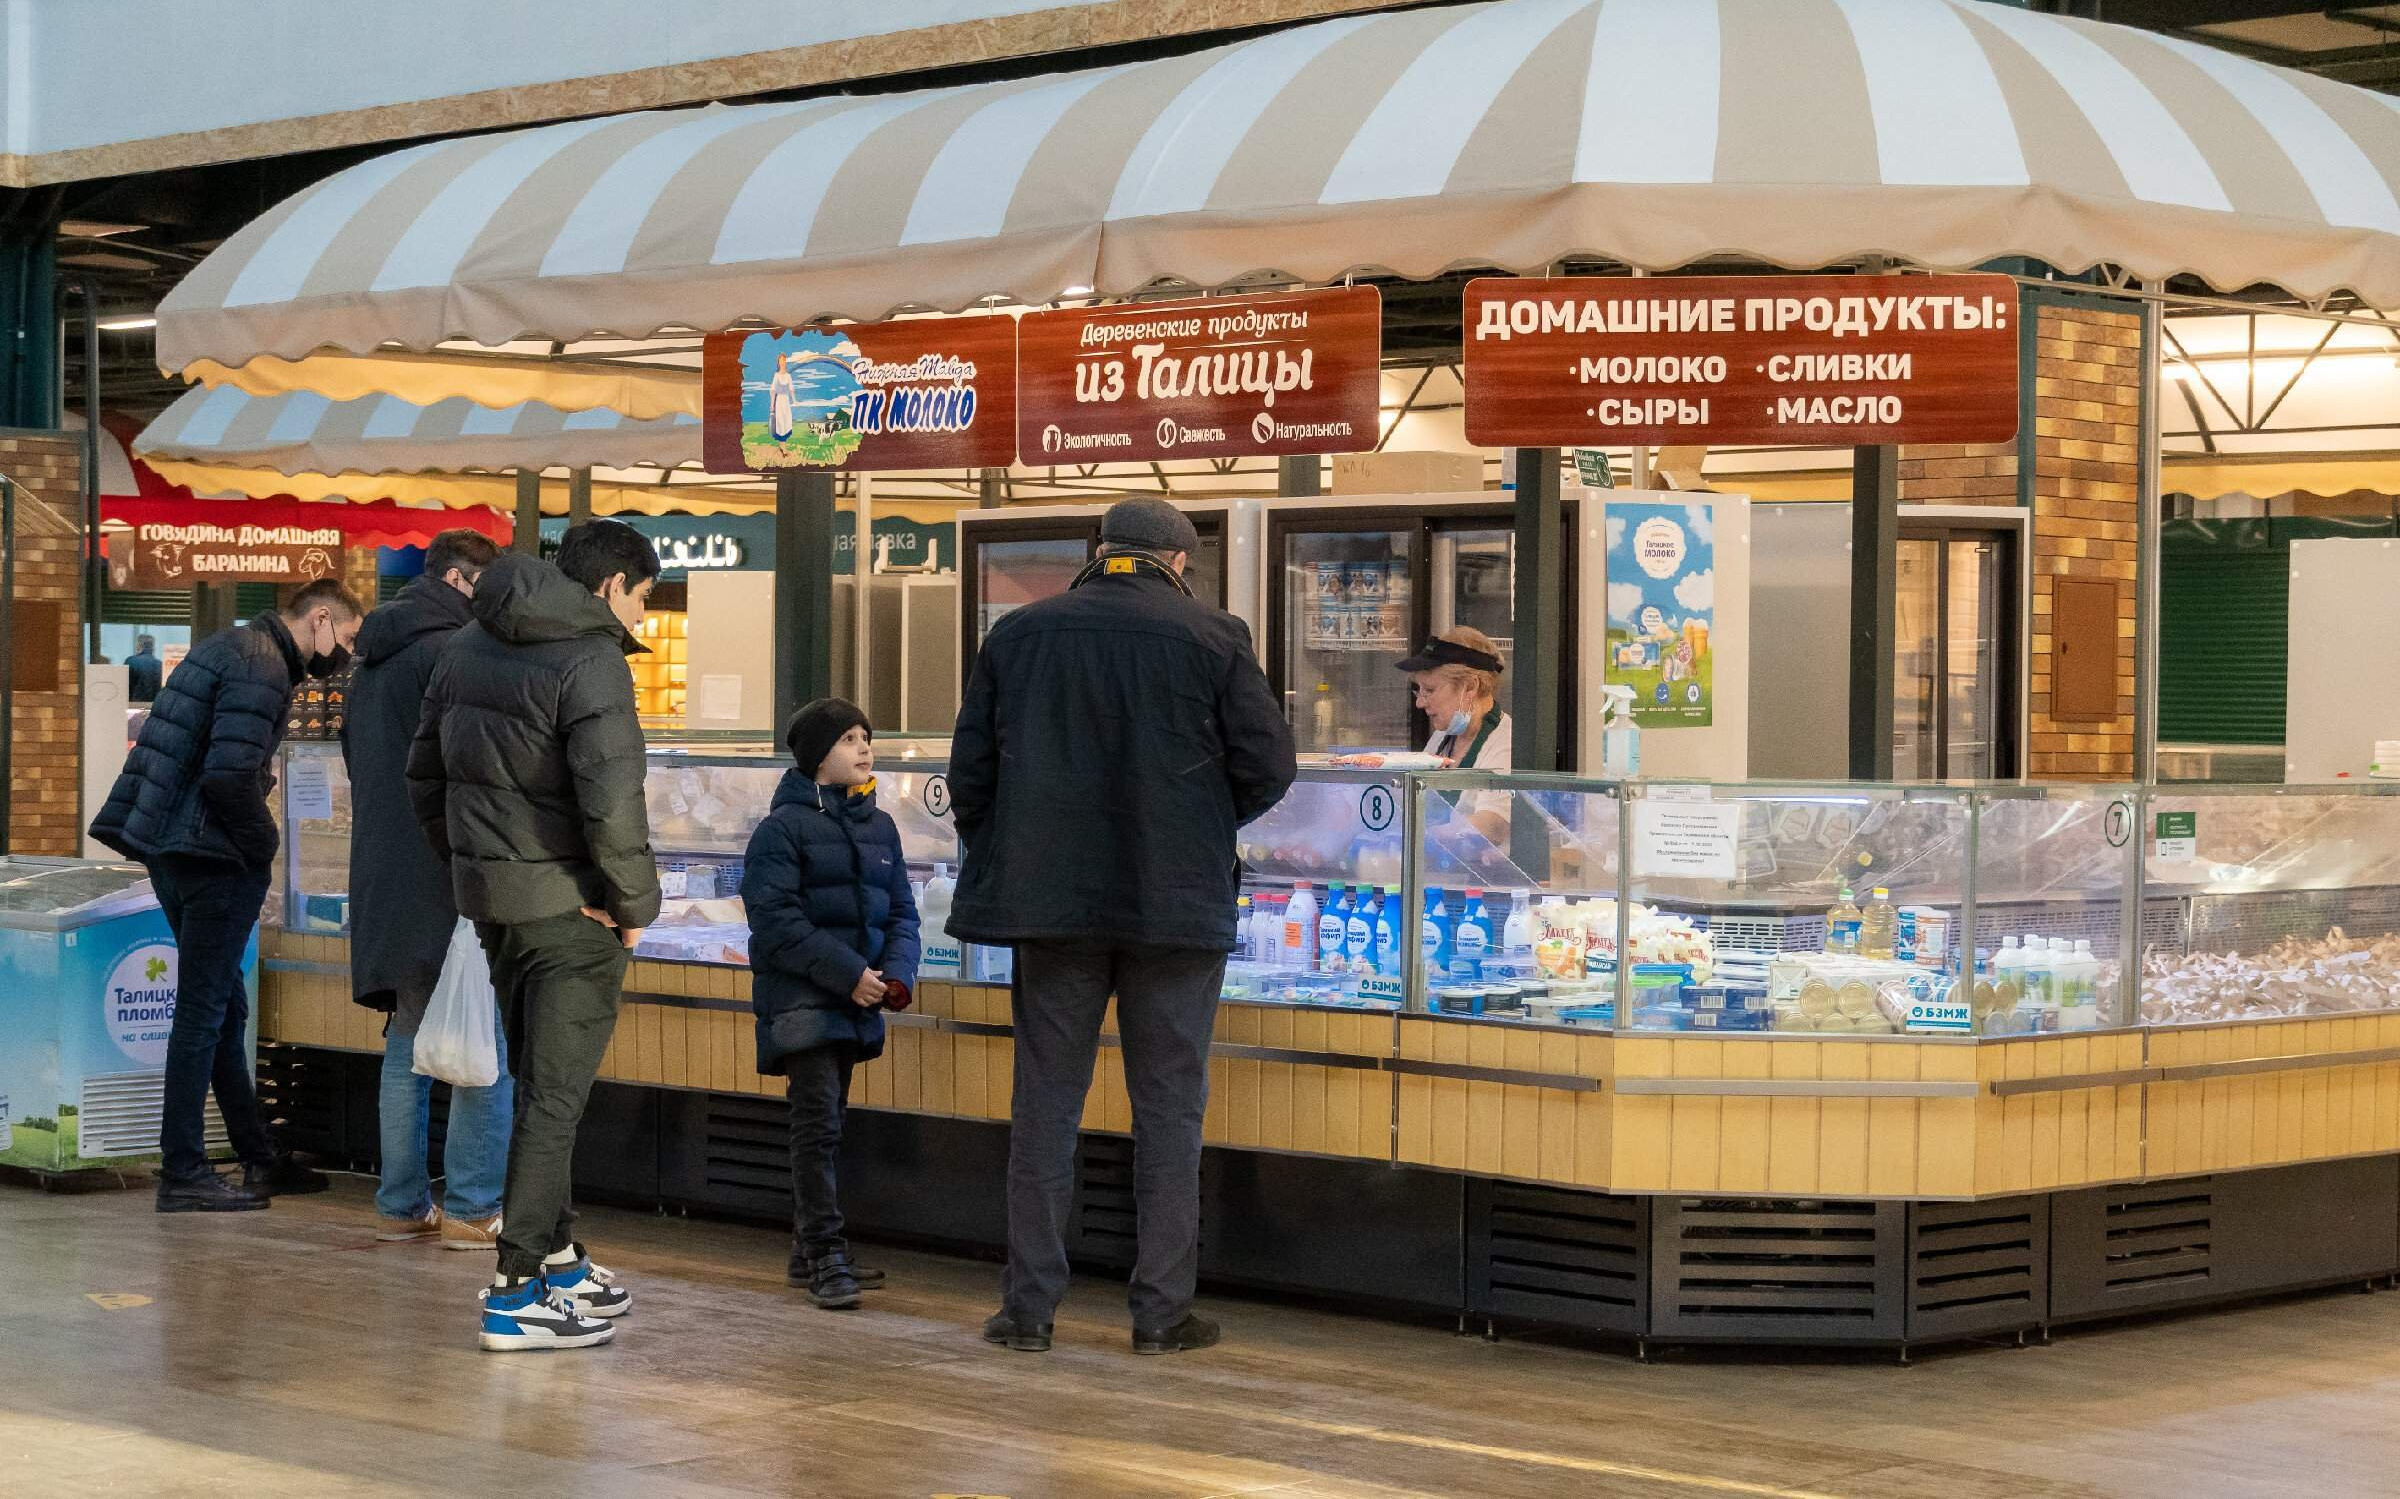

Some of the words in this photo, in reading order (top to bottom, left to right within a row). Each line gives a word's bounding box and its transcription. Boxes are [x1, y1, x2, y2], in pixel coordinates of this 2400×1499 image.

[1476, 299, 1736, 340] ДОМАШНИЕ
[1745, 296, 2006, 337] ПРОДУКТЫ:
[1080, 317, 1200, 347] Деревенские
[1208, 310, 1308, 340] продукты
[1075, 361, 1125, 402] из
[1132, 342, 1313, 407] Талицы
[851, 391, 884, 431] ПК
[888, 388, 975, 431] МОЛОКО
[1179, 426, 1226, 443] Свежесть
[1276, 421, 1353, 440] Натуральность
[1064, 432, 1132, 450] Экологичность
[140, 524, 235, 545] ГОВЯДИНА
[238, 526, 340, 546] ДОМАШНЯЯ
[193, 554, 290, 573] БАРАНИНА
[1372, 795, 1382, 821] 8
[934, 947, 959, 959] БЗМЖ
[1371, 981, 1401, 994] БЗМЖ
[1925, 1006, 1968, 1019] БЗМЖ
